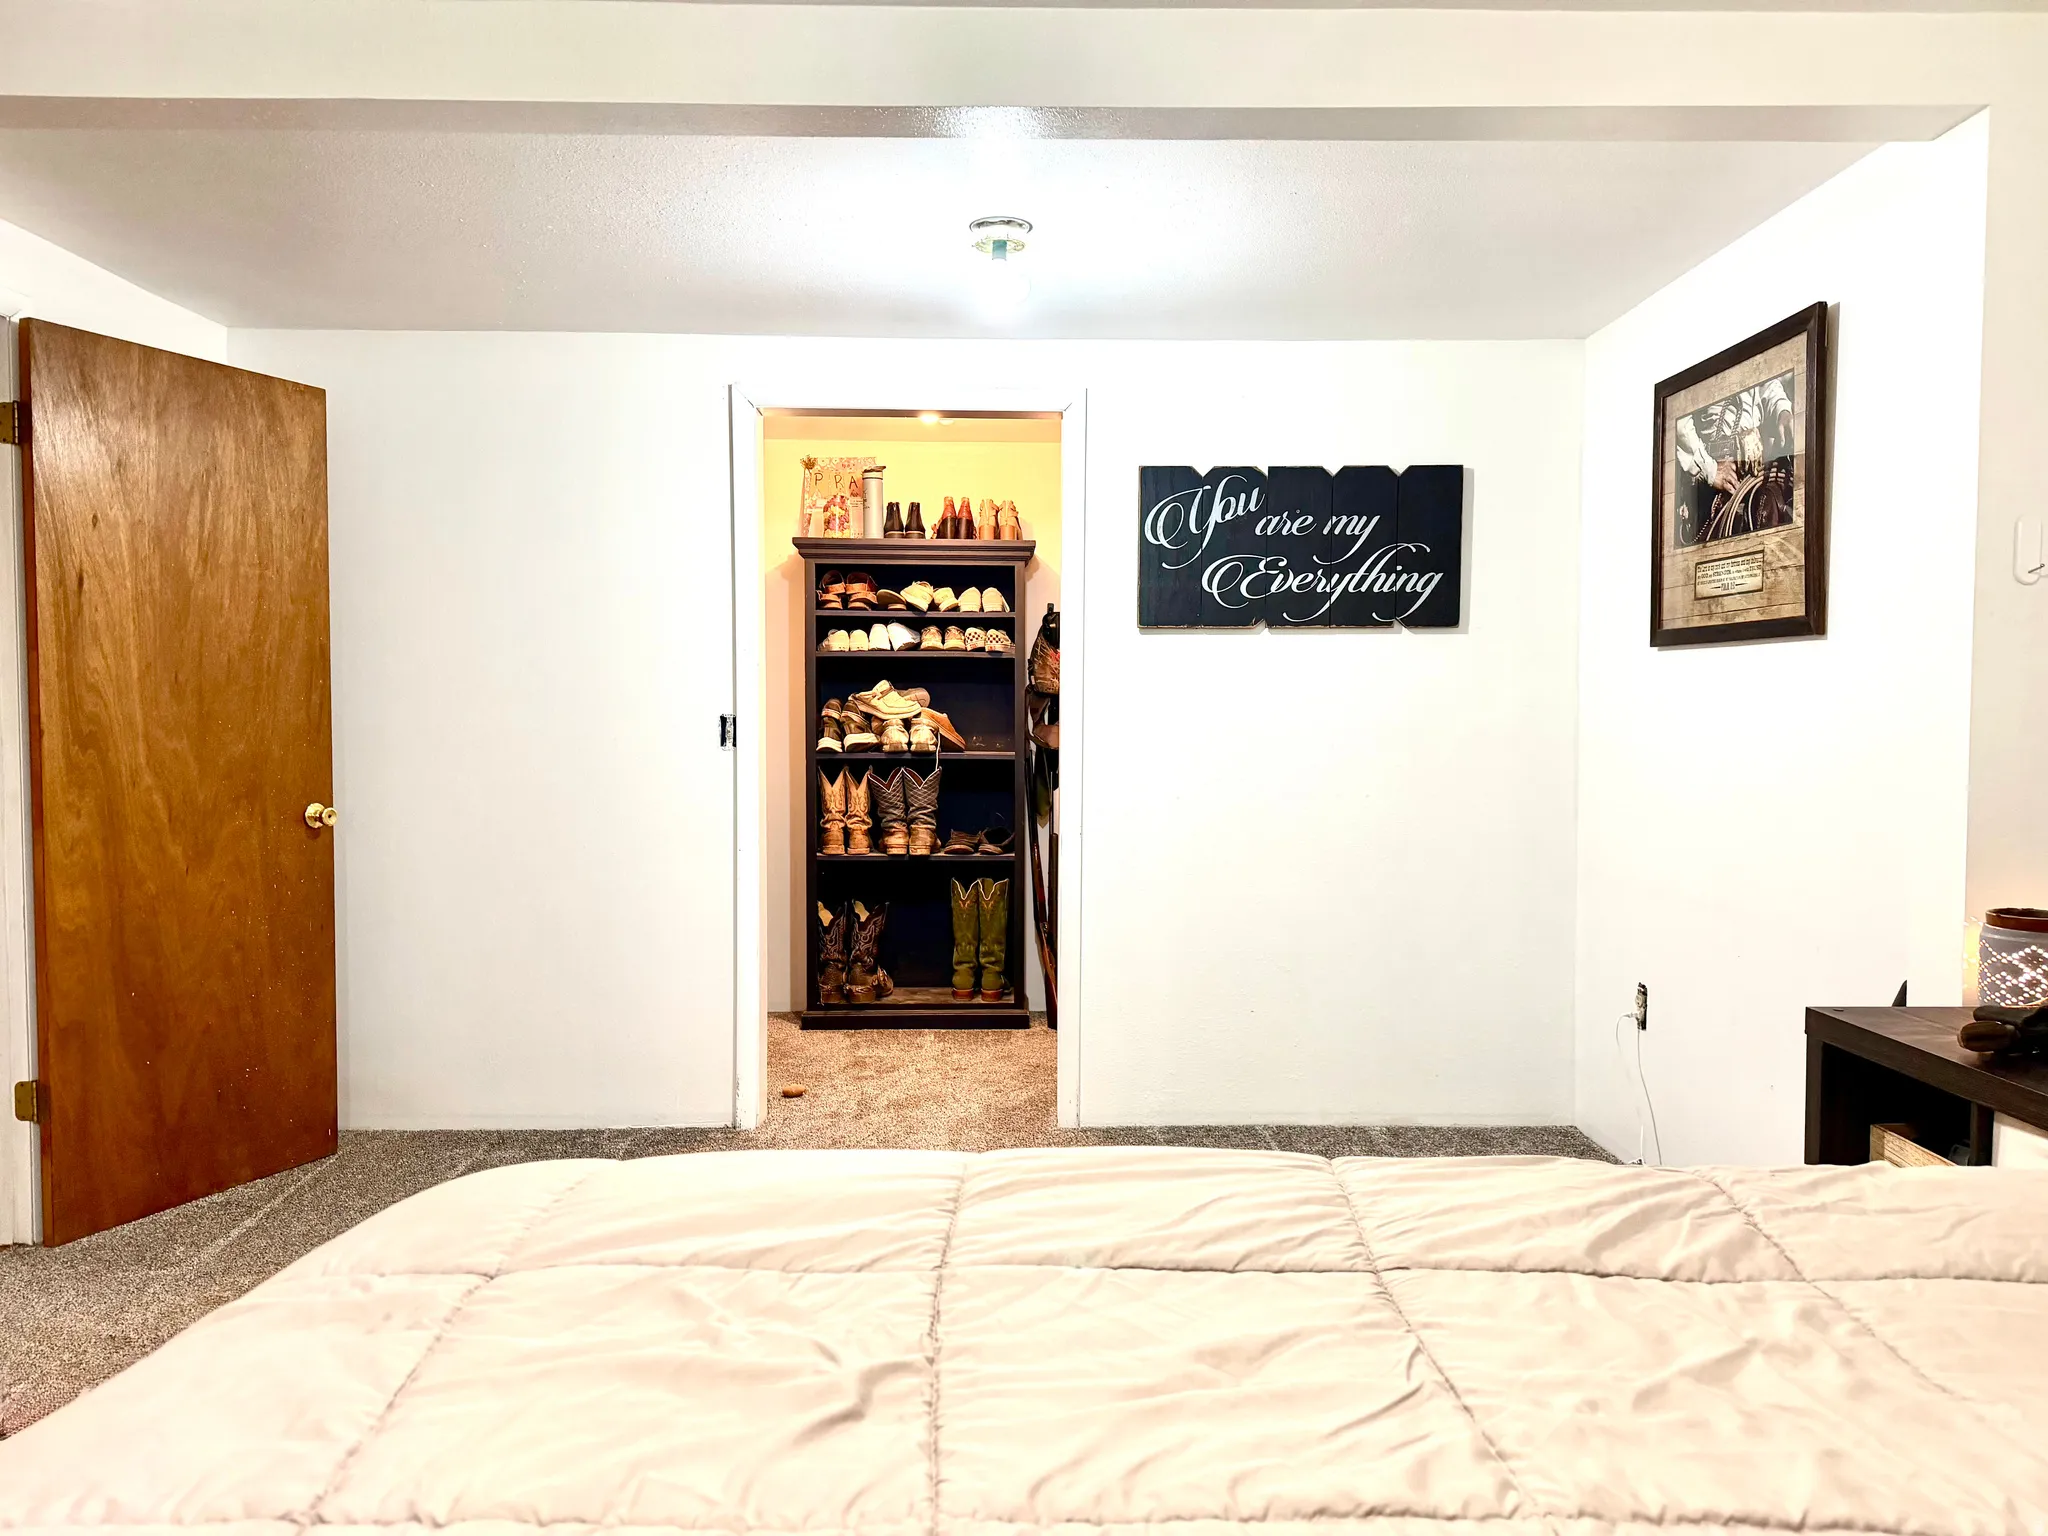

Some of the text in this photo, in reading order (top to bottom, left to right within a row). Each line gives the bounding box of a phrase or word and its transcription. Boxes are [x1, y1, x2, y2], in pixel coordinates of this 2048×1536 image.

[1144, 475, 1381, 570] You are my
[1202, 543, 1444, 622] Everything
